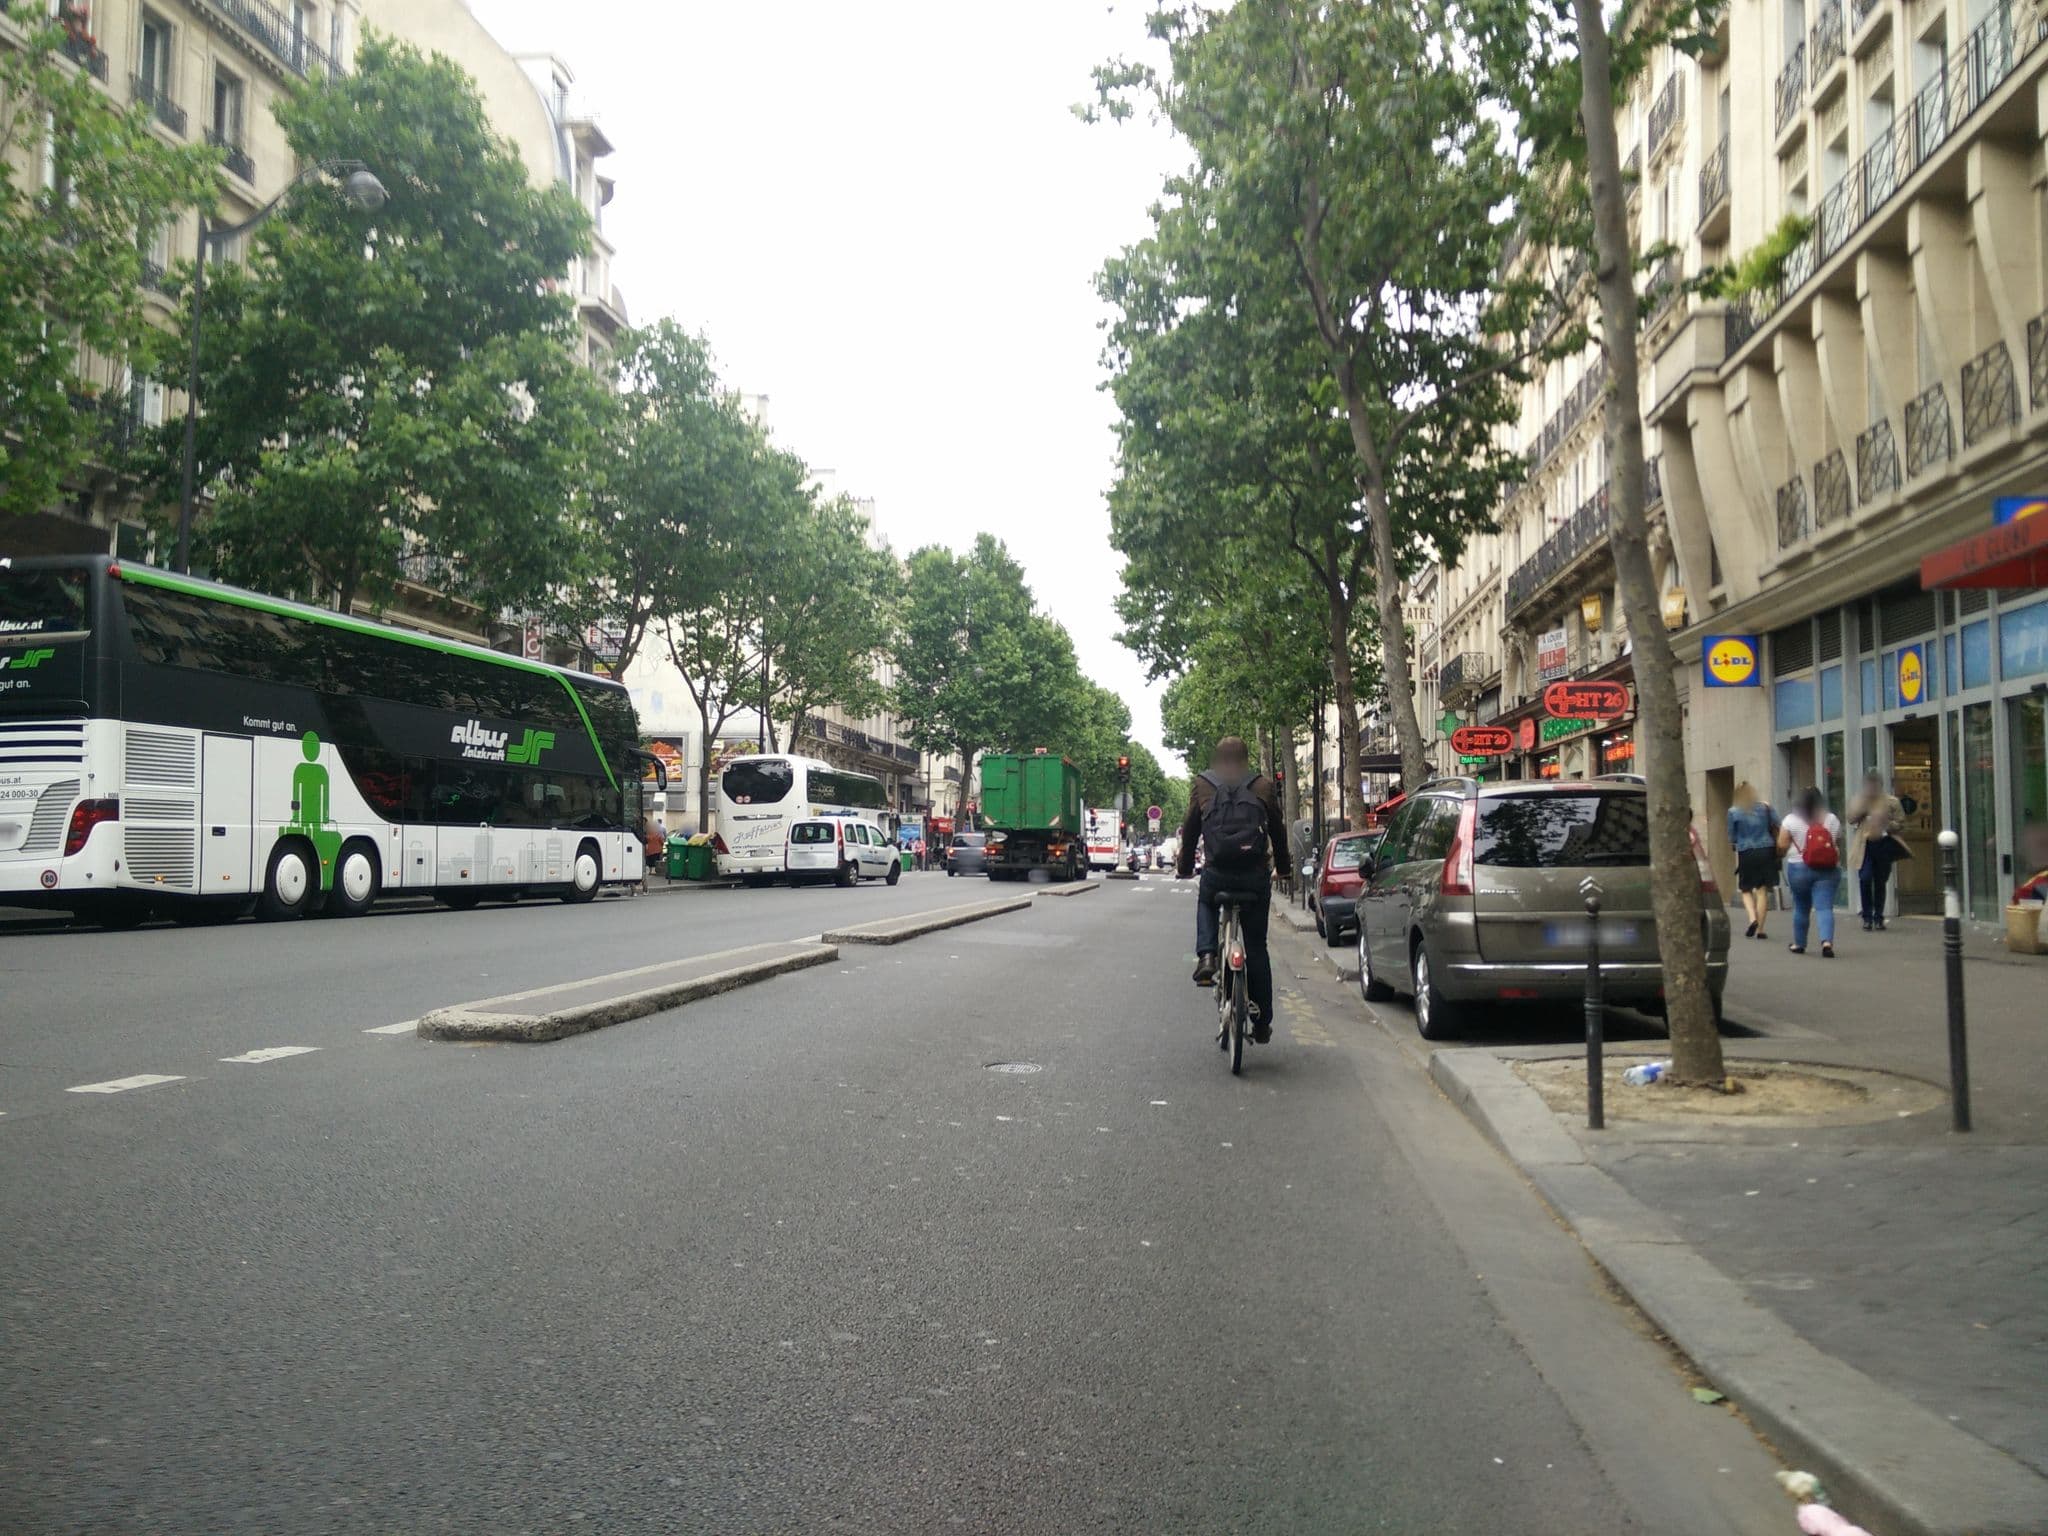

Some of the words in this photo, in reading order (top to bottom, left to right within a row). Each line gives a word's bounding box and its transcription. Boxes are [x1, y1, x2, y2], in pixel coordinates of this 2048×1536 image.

[1603, 692, 1624, 707] 26
[243, 715, 270, 728] Kommt
[272, 721, 284, 732] gut
[286, 723, 297, 731] an.
[450, 719, 508, 748] albus
[12, 789, 39, 798] 000-30
